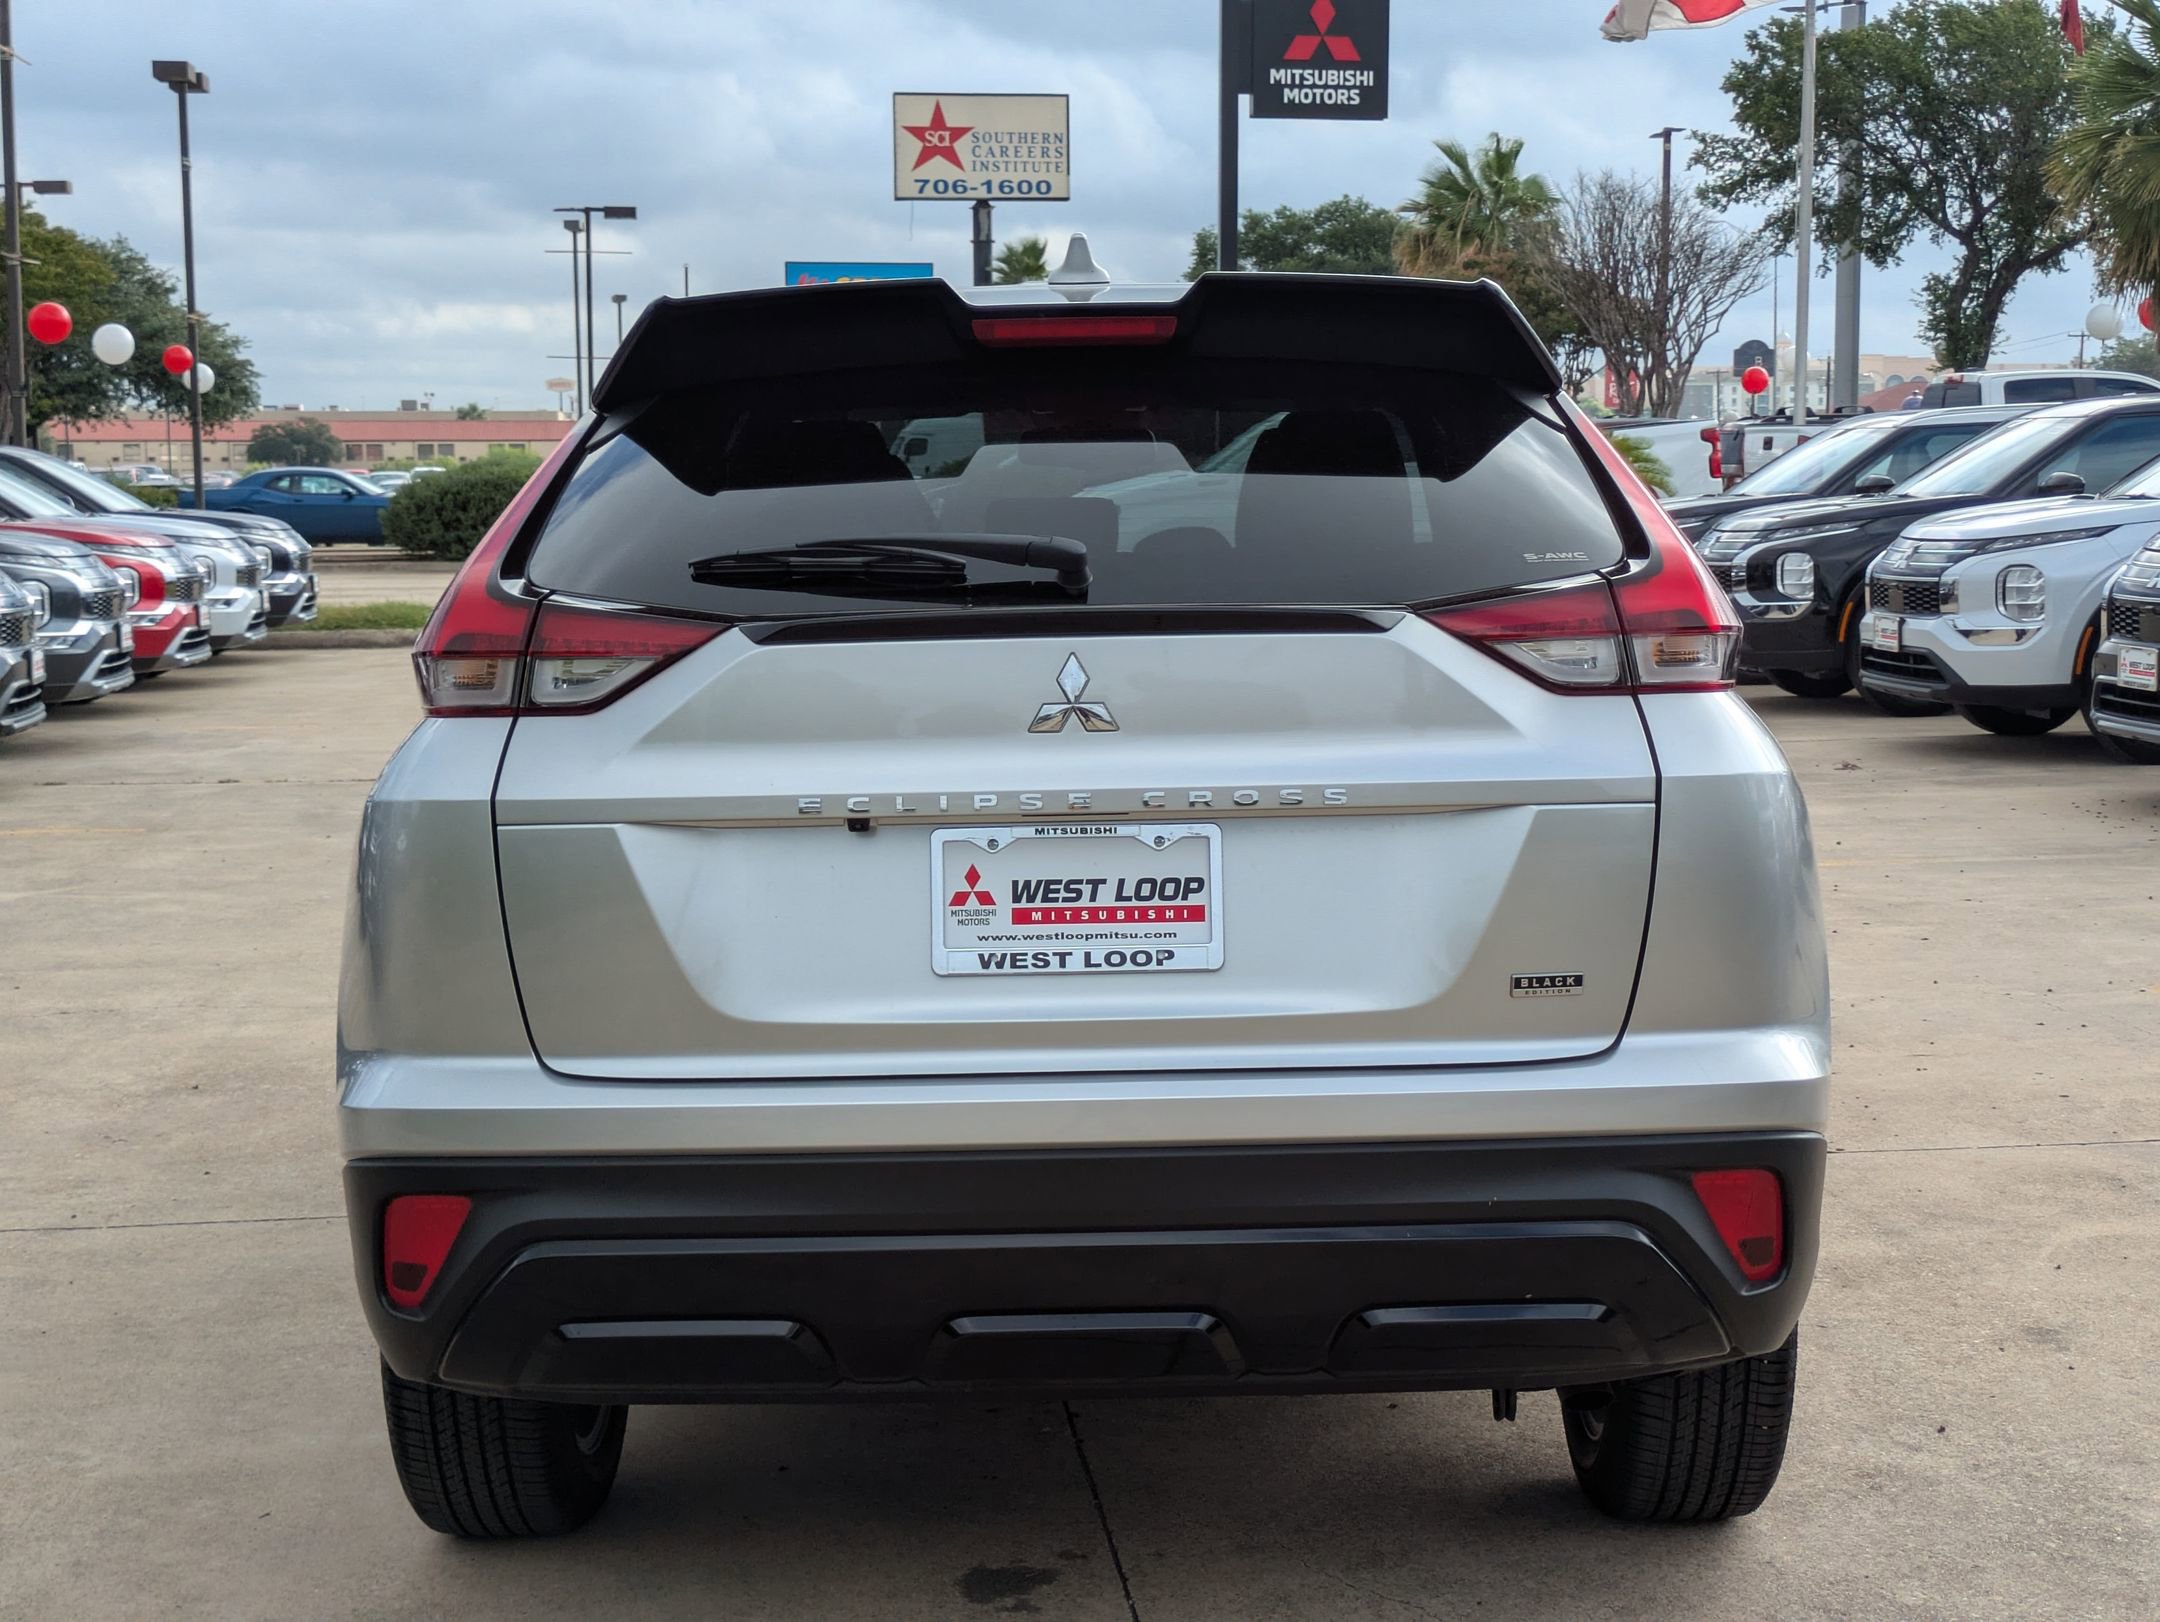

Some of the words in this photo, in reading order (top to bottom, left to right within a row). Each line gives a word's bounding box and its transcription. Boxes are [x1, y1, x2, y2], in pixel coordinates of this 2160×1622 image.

[1269, 68, 1374, 87] MITSUBISHI
[1283, 88, 1360, 105] MOTORS
[924, 130, 952, 147] SCI
[971, 131, 1064, 144] SOUTHERN
[971, 145, 1064, 159] CAREERS
[971, 160, 1064, 173] INSTITUTE
[913, 178, 1053, 195] 706-1600
[1523, 552, 1588, 560] S-AWC
[798, 792, 1092, 814] ECLIPSE
[1142, 788, 1348, 808] CROSS
[1034, 826, 1118, 836] MITSUBISHI
[1011, 878, 1107, 904] WEST
[1114, 876, 1205, 902] LOOP
[950, 908, 998, 918] MITSUBISHI
[1031, 908, 1188, 921] MITSUBISHI
[957, 917, 991, 926] MOTORS
[976, 930, 1177, 942] www.westloopmitsu.com
[978, 951, 1073, 970] WEST
[1084, 949, 1176, 968] LOOP
[1520, 976, 1576, 988] BLACK
